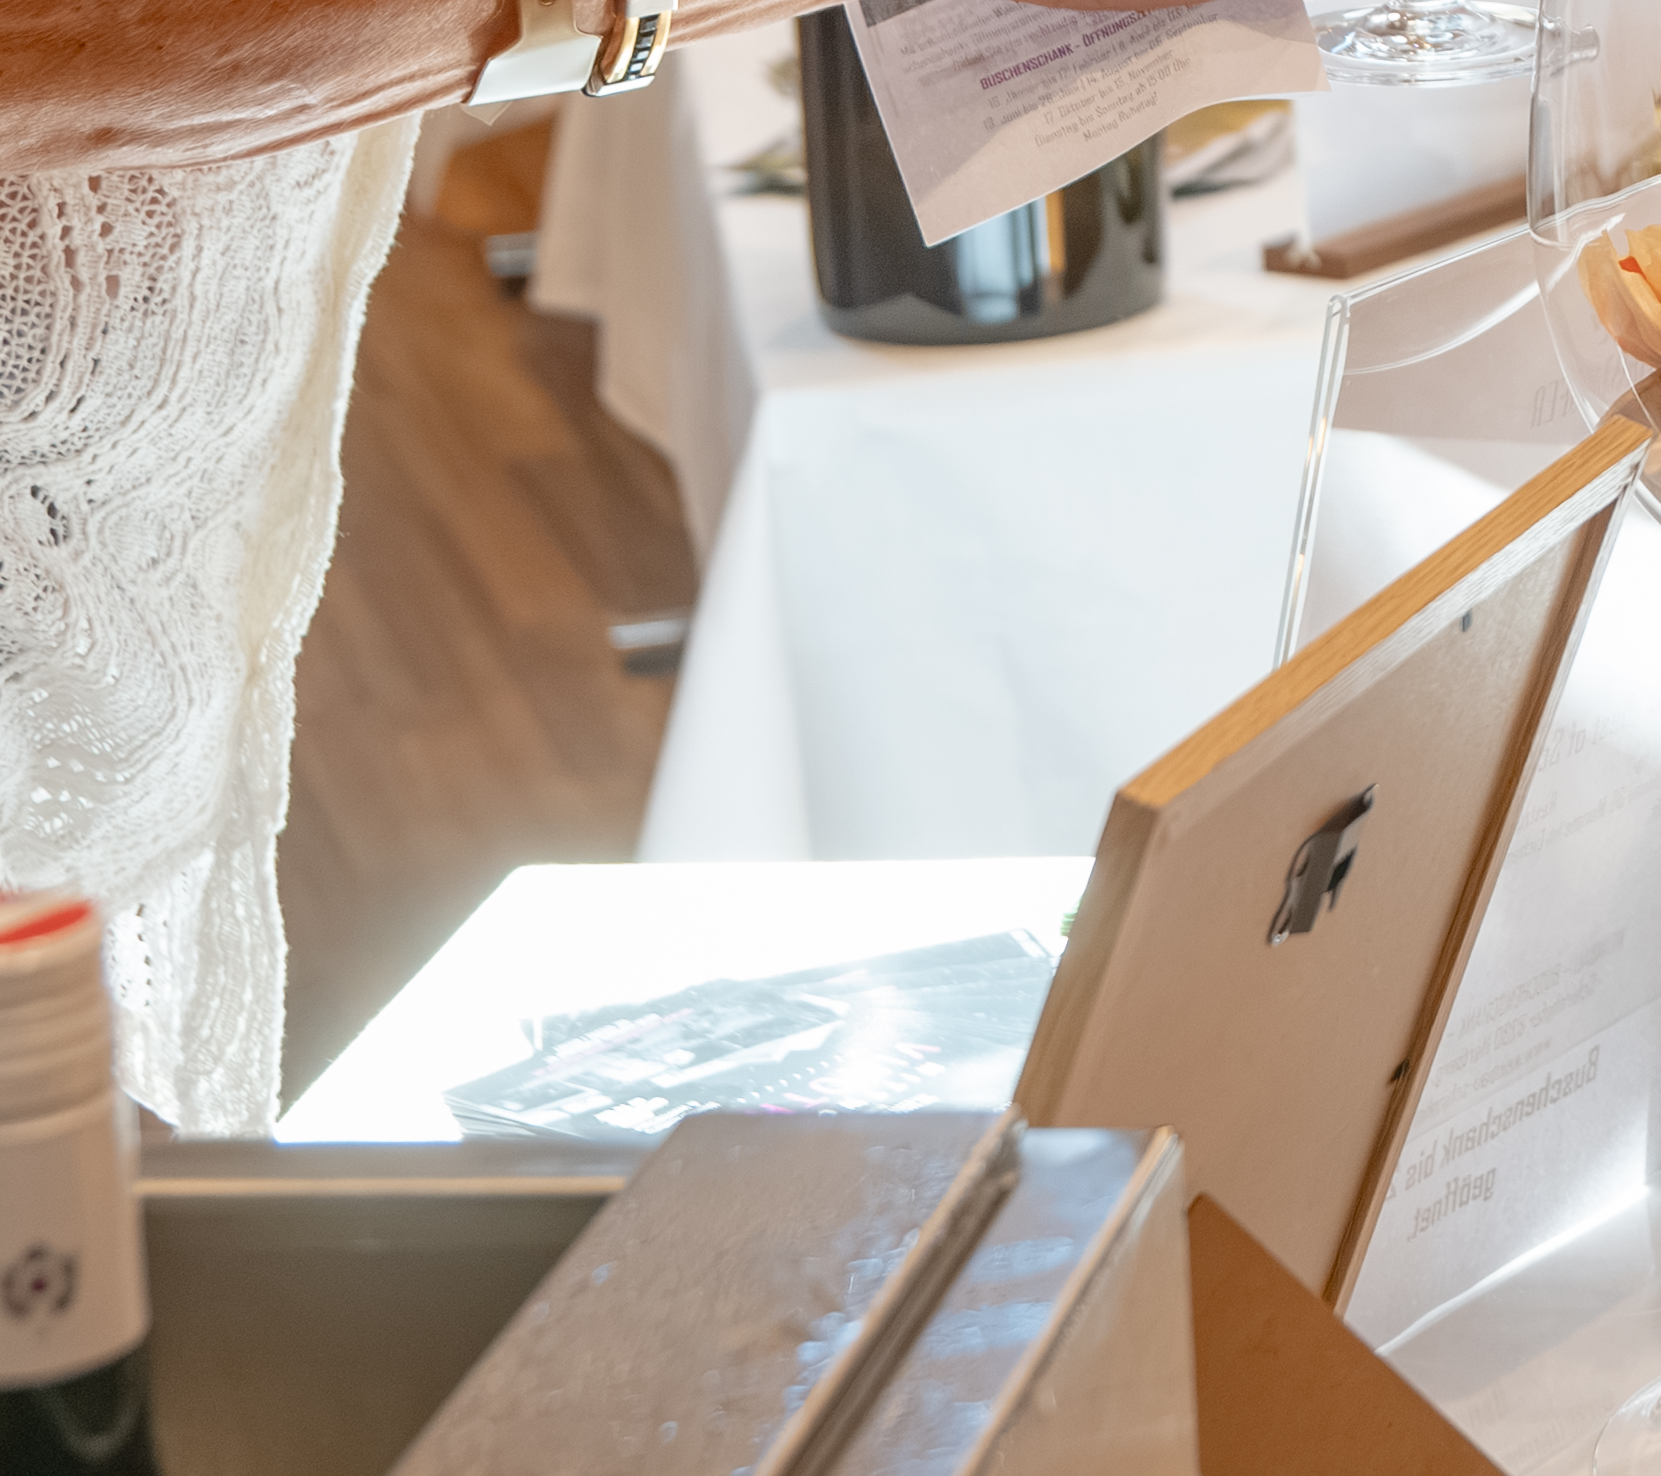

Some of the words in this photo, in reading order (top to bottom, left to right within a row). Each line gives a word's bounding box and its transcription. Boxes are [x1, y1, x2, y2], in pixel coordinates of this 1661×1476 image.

[980, 44, 1073, 89] BUSCHENSCHANK
[1126, 50, 1175, 80] November
[1083, 117, 1118, 142] Montag
